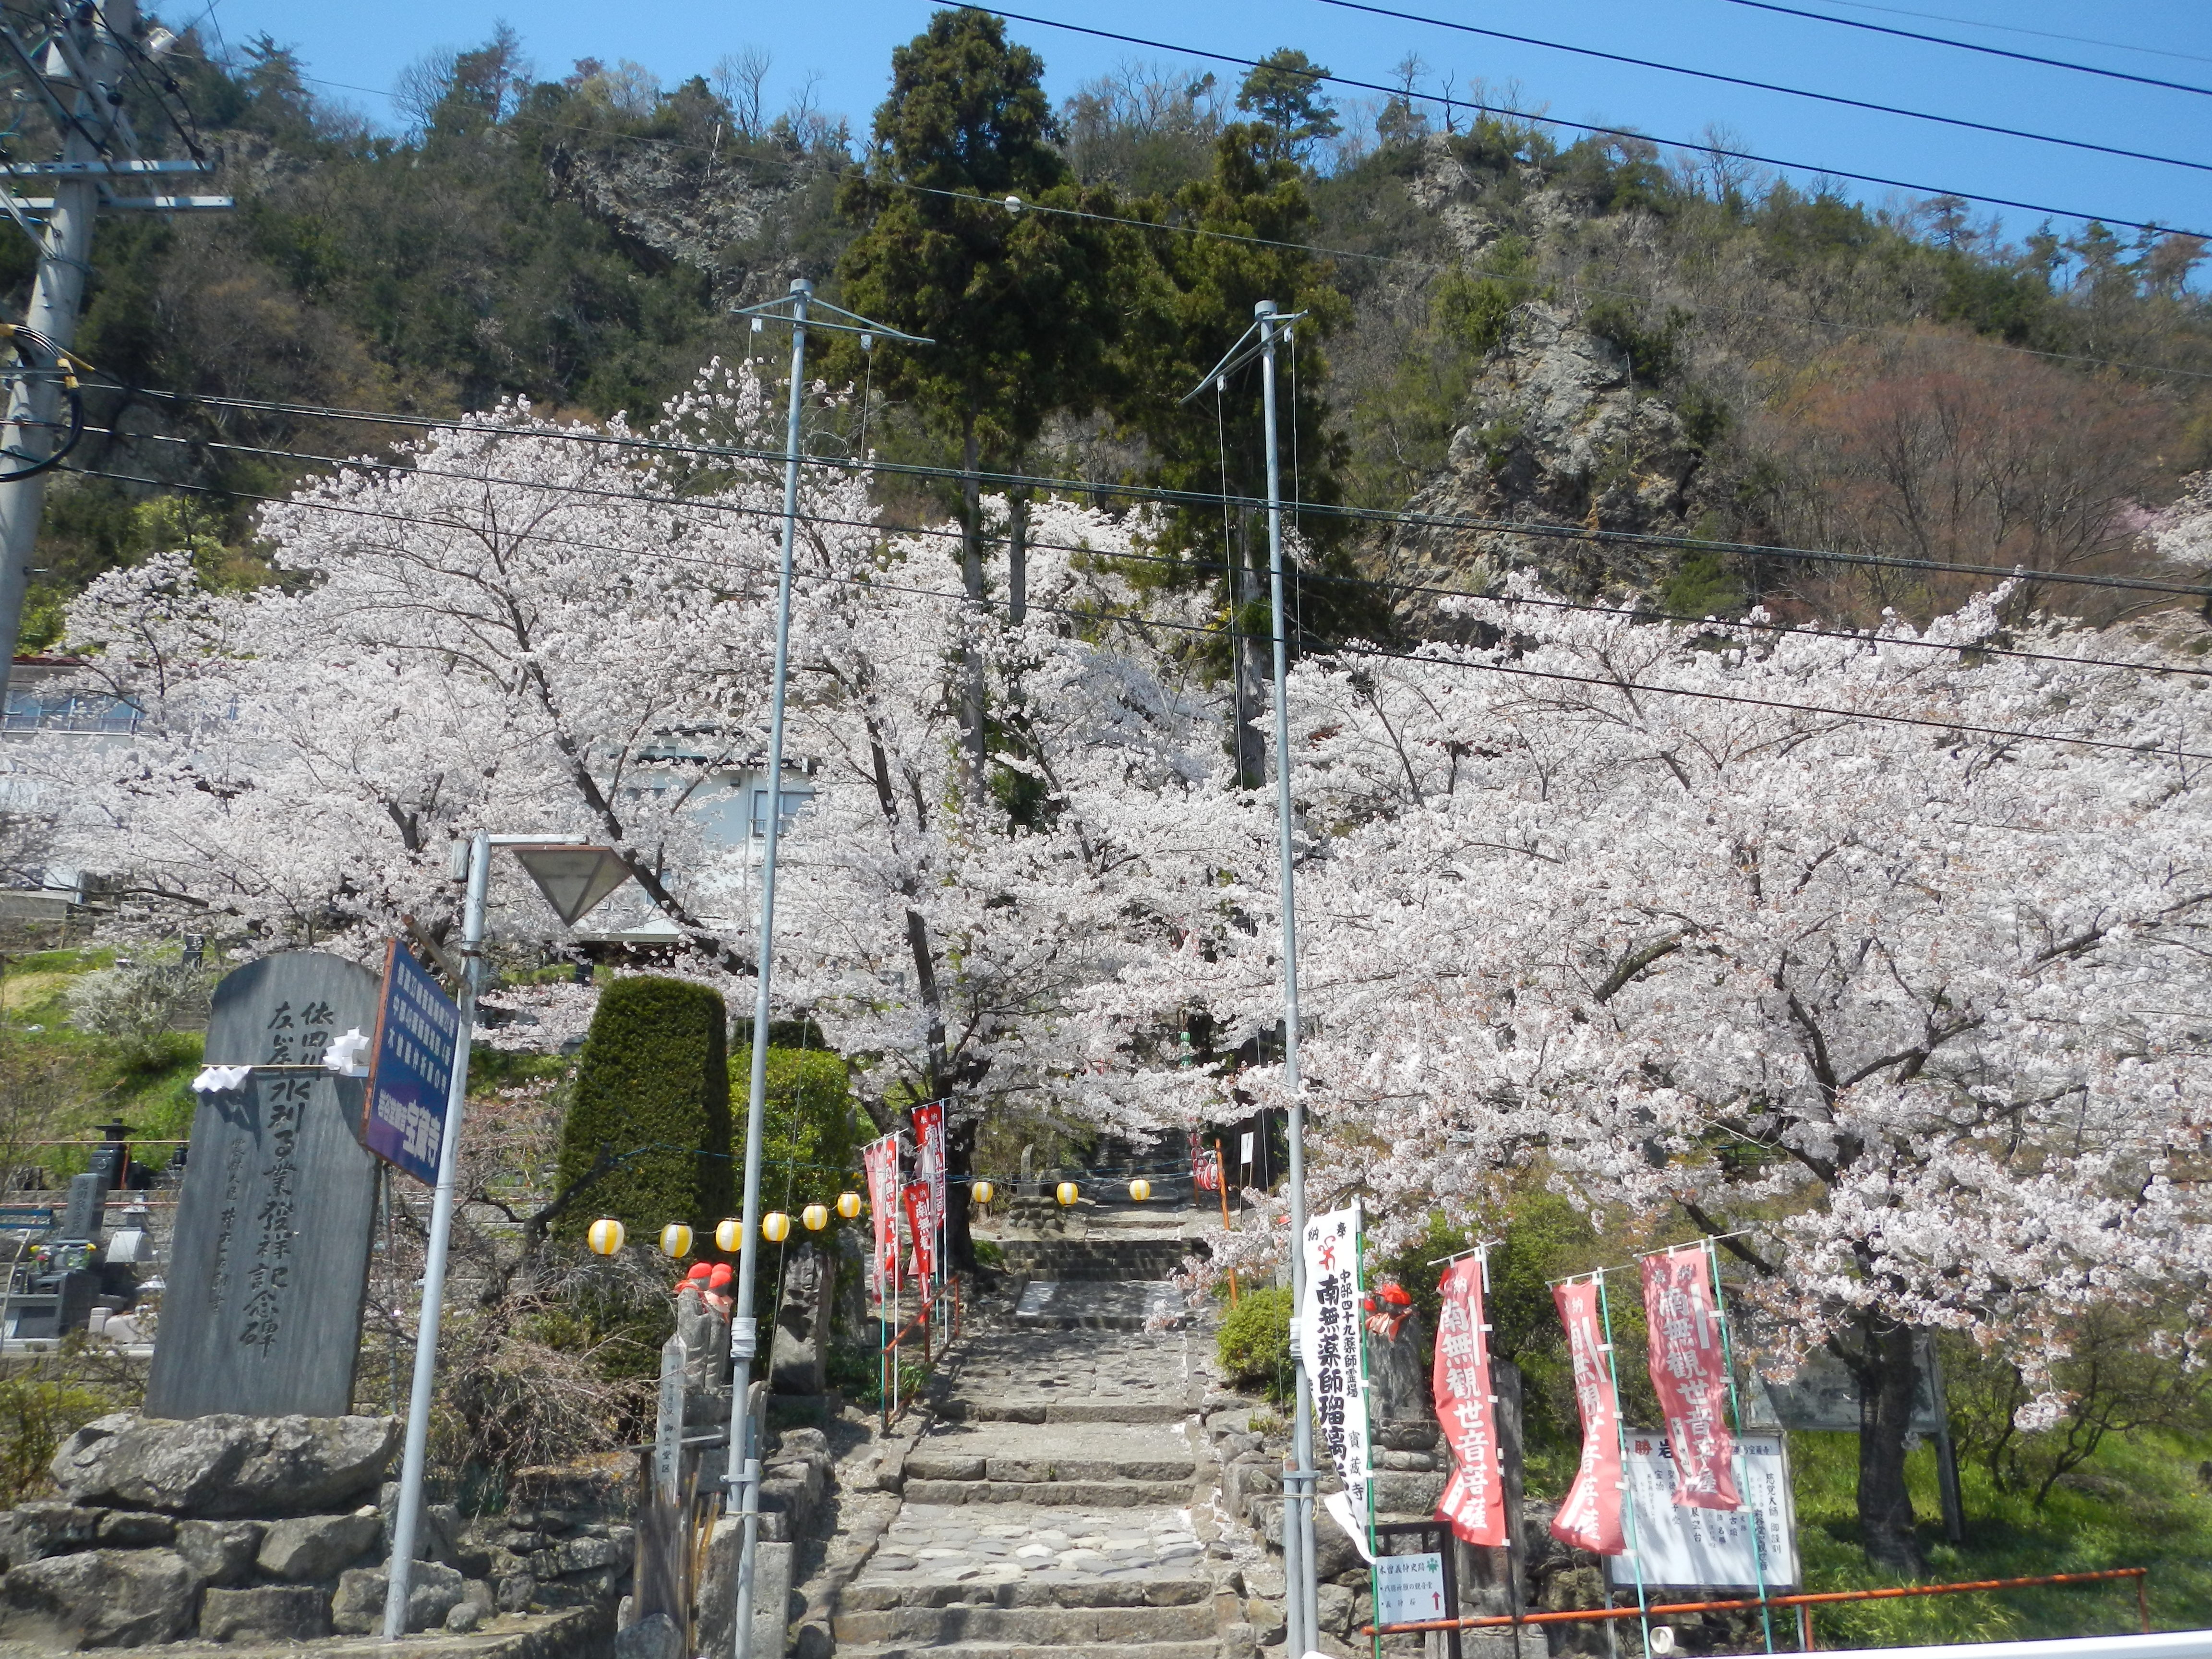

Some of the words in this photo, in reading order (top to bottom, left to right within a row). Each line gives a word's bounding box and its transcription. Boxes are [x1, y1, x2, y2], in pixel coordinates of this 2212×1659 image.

[1340, 1268, 1358, 1398] 中部四十九薬師霊場
[1440, 1298, 1489, 1529] 南無観世音菩薩
